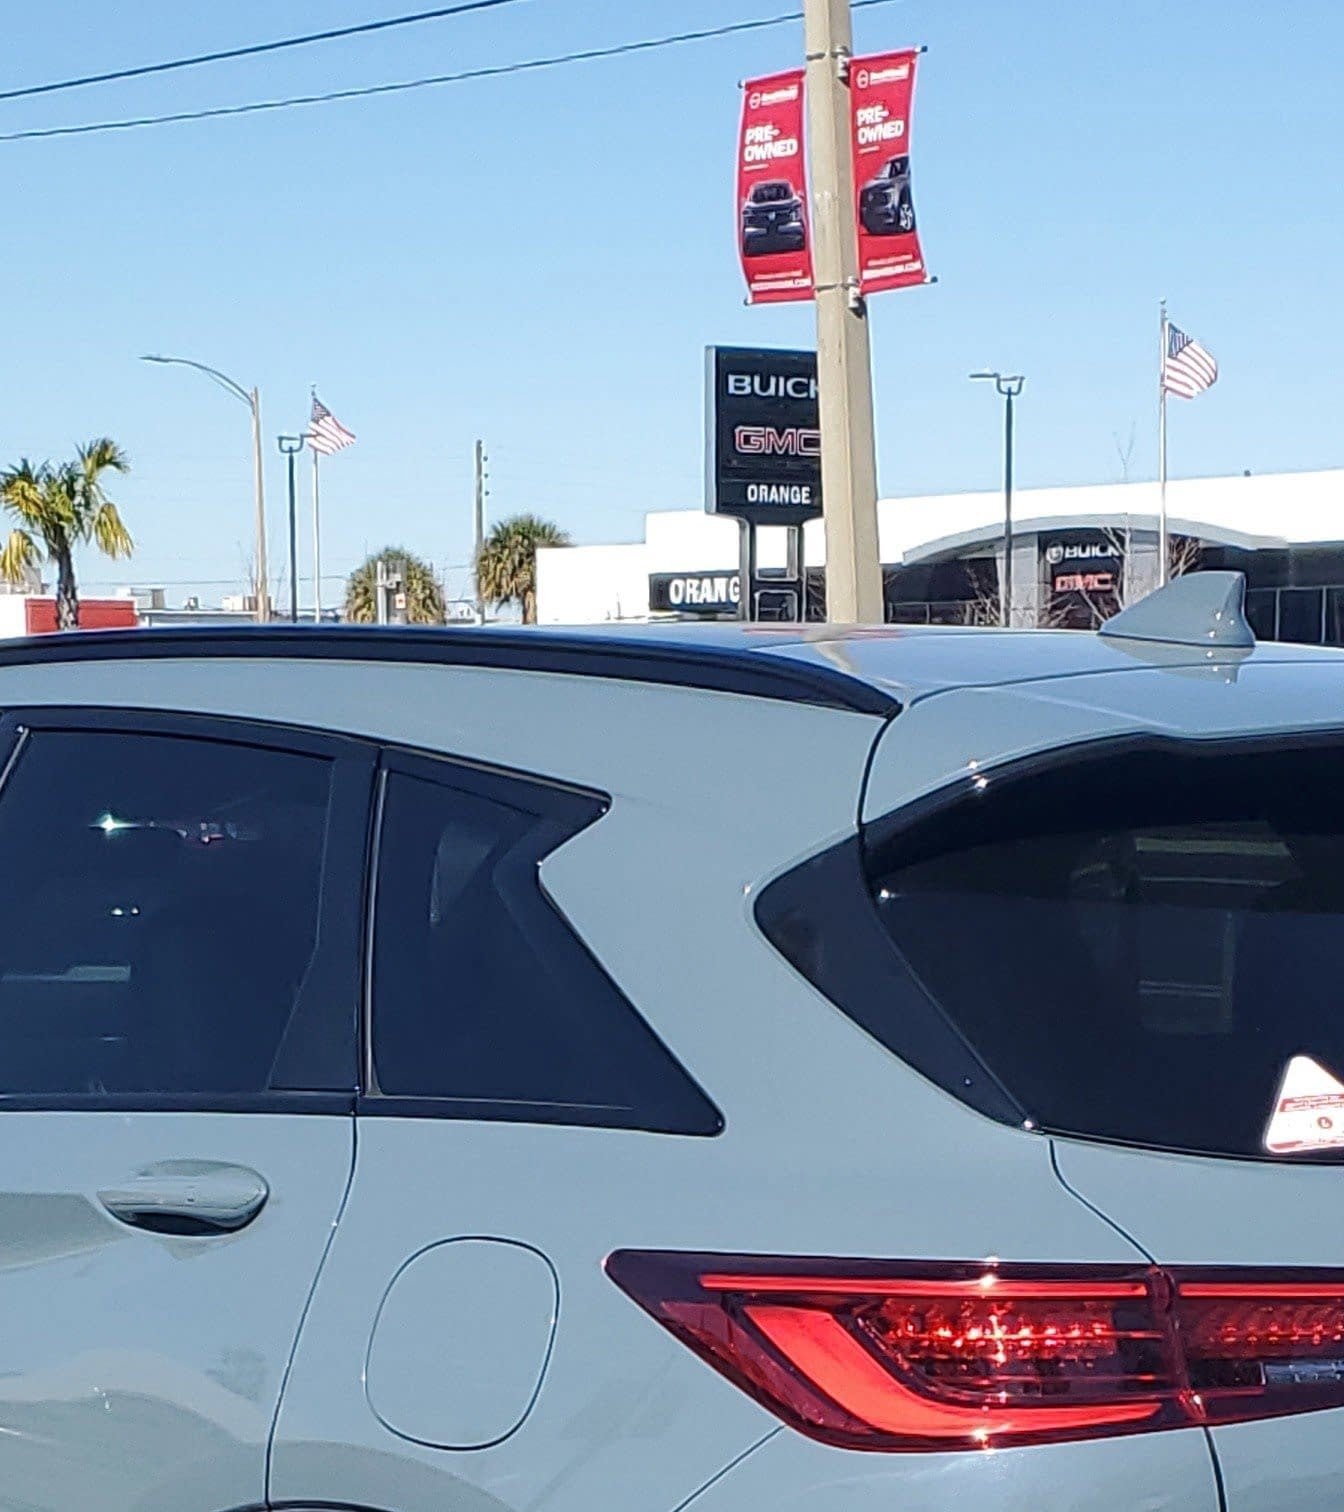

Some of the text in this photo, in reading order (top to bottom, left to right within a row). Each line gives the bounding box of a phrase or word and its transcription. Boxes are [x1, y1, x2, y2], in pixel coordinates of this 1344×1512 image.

[857, 104, 889, 127] PRE-
[744, 124, 780, 145] PRE-
[858, 120, 904, 145] OWNED
[744, 138, 798, 162] OWNED
[734, 426, 822, 456] GMC
[747, 484, 811, 504] ORANGE
[1064, 544, 1120, 559] BUICK
[669, 577, 741, 604] ORANG
[1055, 573, 1113, 592] GMC
